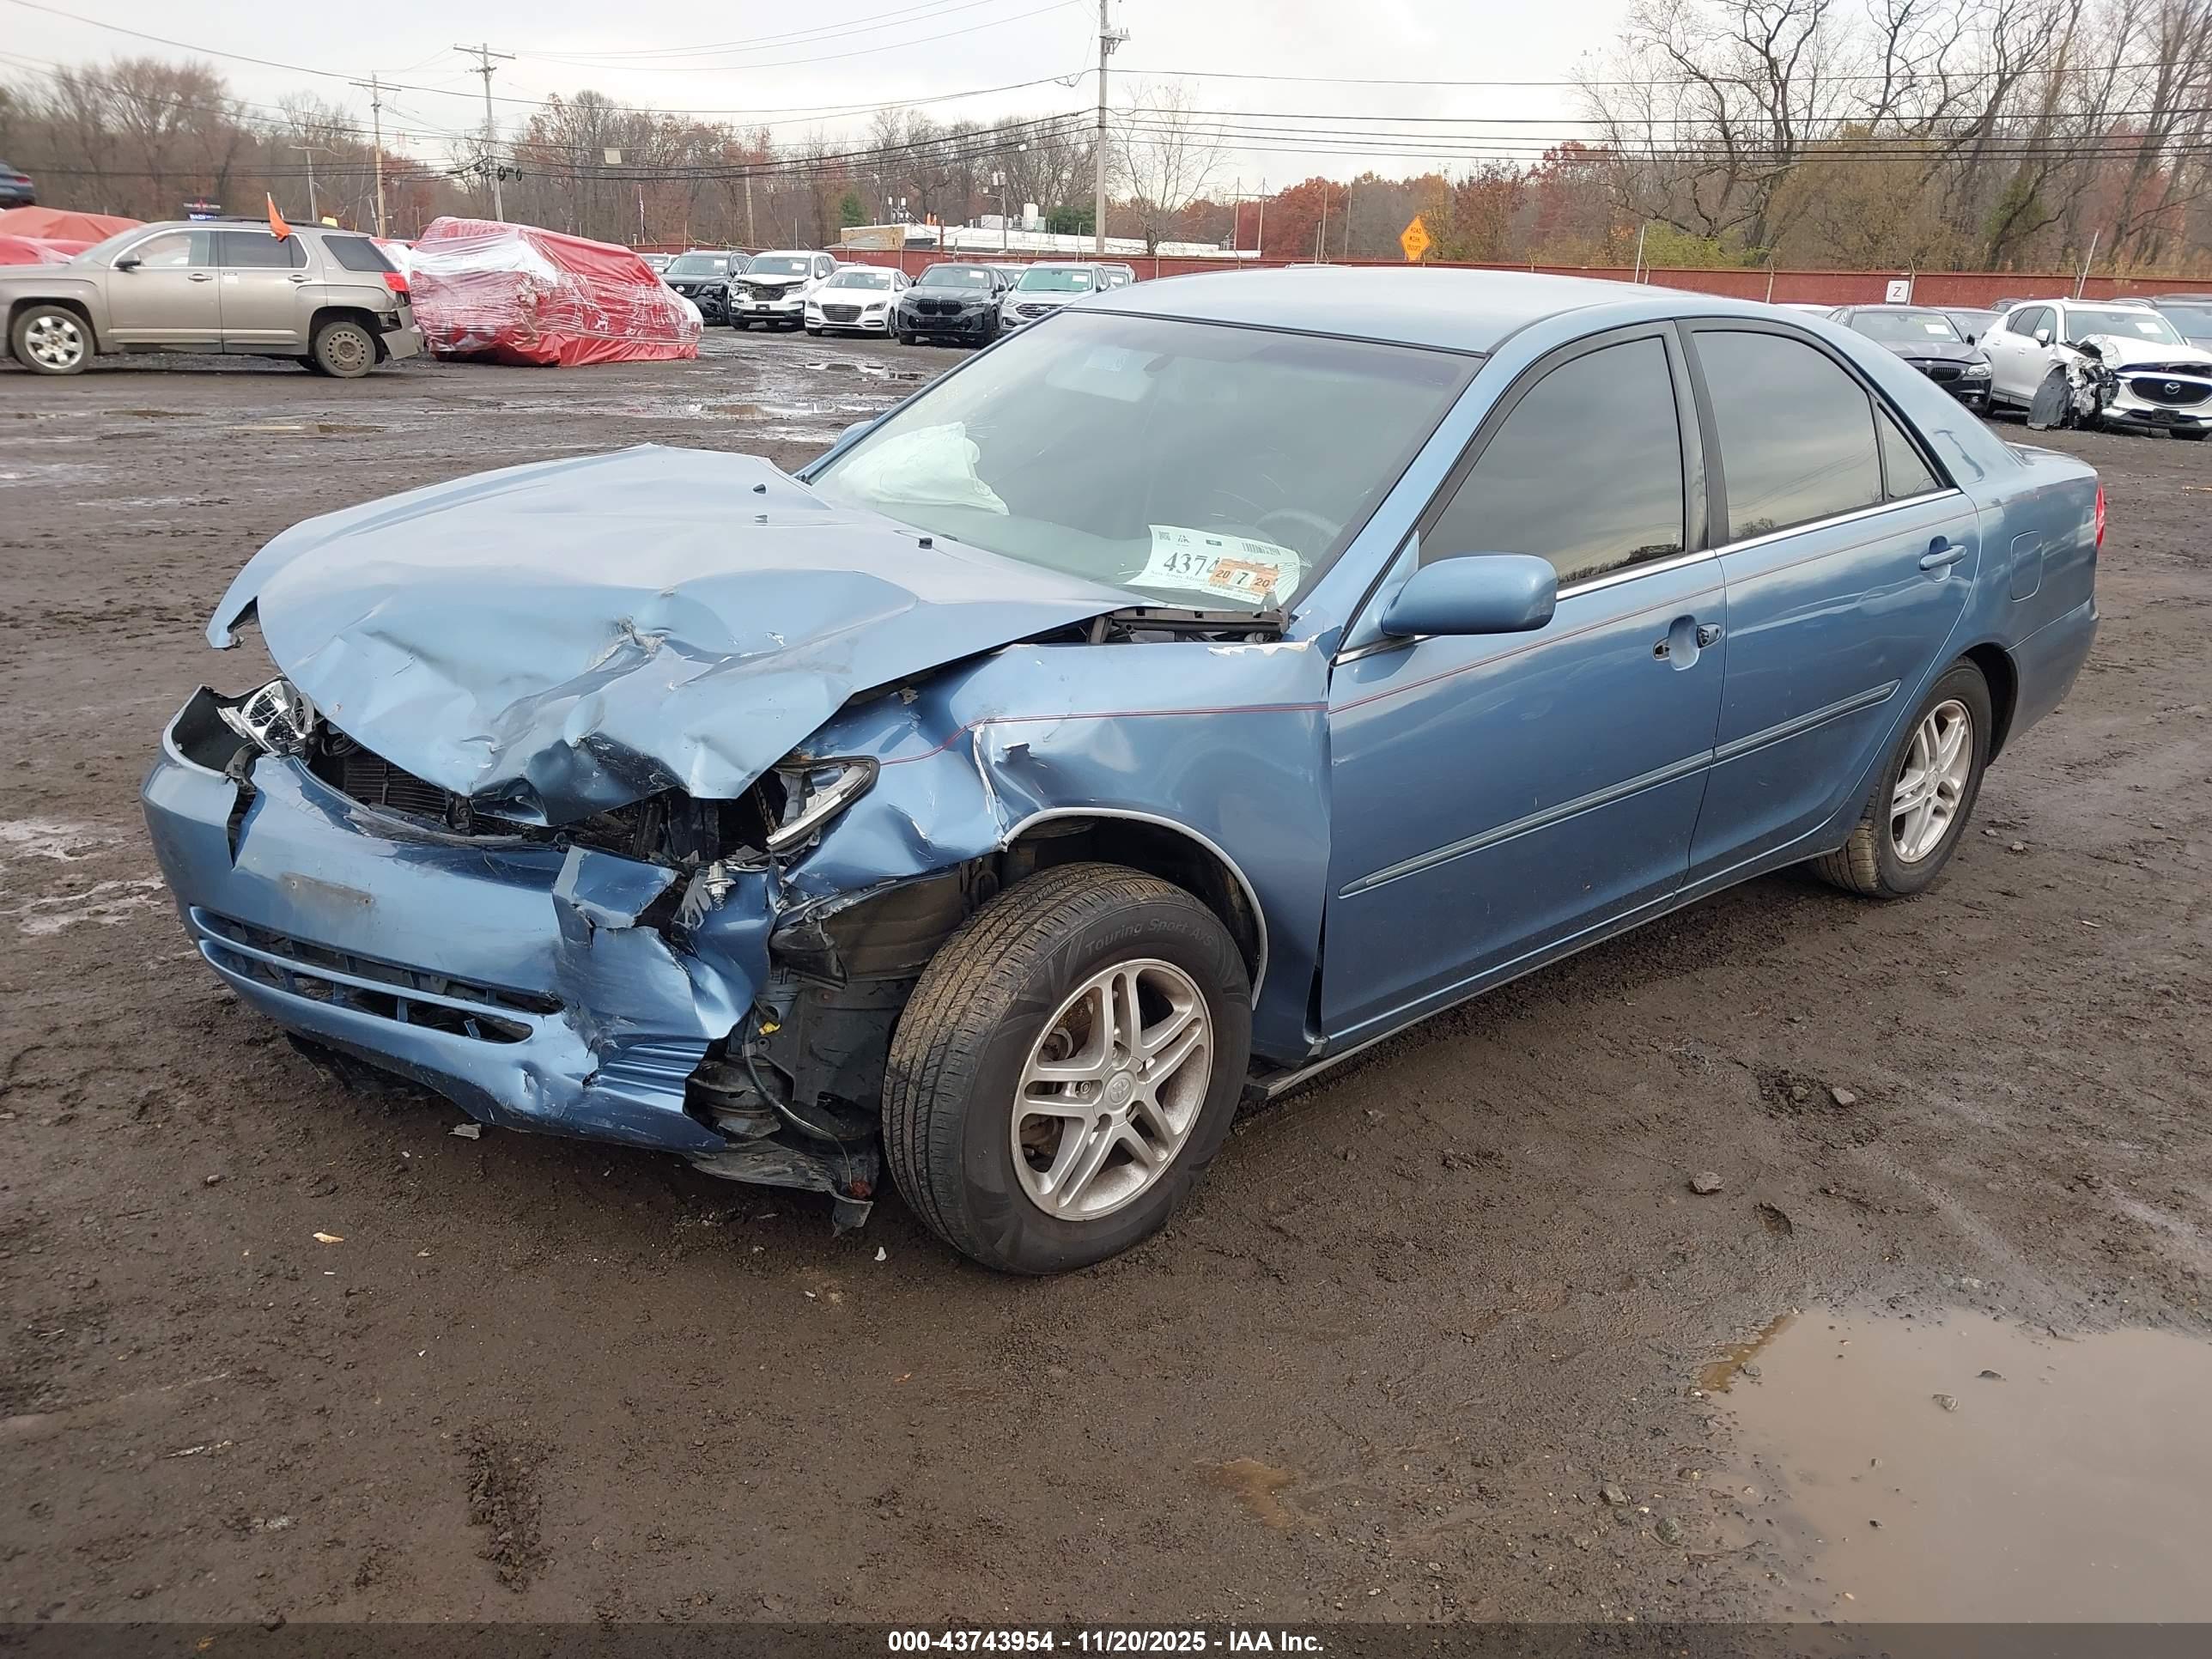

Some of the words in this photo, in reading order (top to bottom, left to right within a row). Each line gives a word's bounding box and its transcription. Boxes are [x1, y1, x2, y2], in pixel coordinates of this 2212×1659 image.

[1893, 286, 1902, 297] Z
[1215, 569, 1231, 579] 20
[1237, 572, 1249, 585] 7
[1254, 577, 1271, 587] 20
[1085, 922, 1143, 956] Touring
[1147, 918, 1188, 933] Sport
[1189, 927, 1215, 946] A/S
